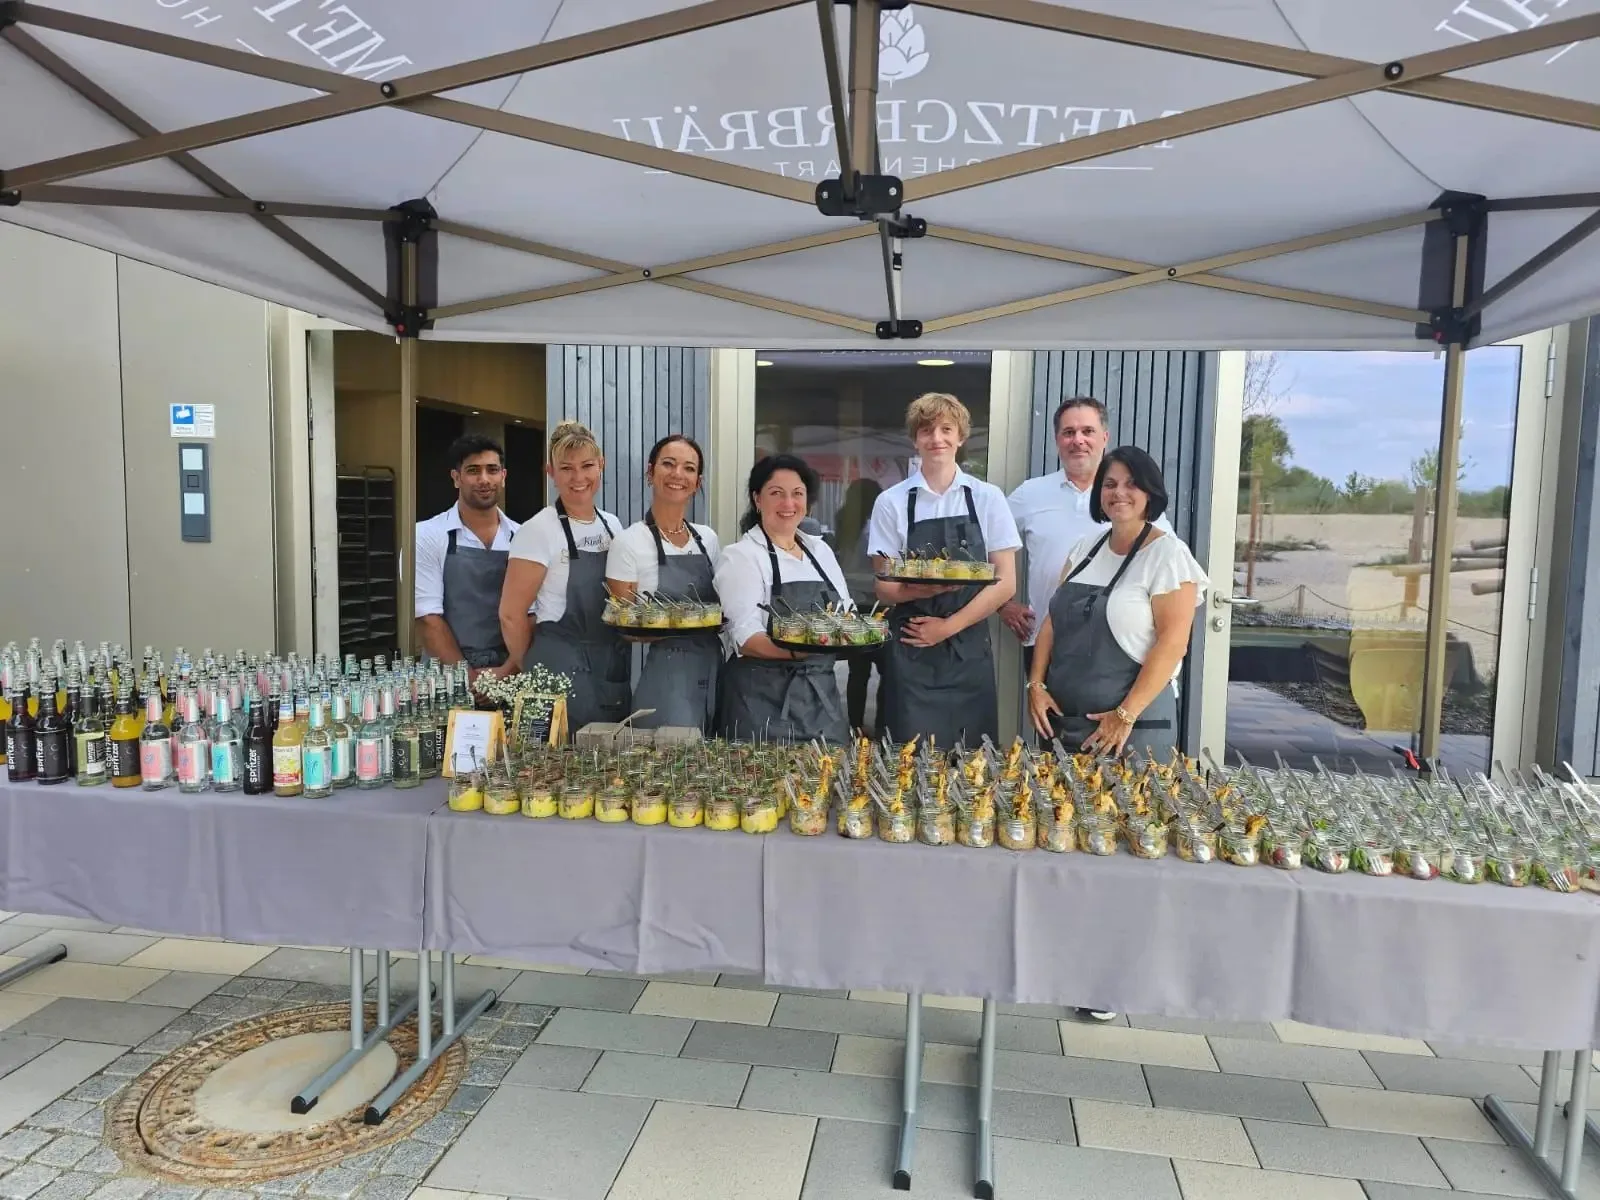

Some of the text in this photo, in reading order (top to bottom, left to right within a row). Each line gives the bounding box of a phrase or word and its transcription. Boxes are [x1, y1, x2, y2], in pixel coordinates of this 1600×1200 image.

[7, 736, 15, 770] spritzer
[36, 738, 45, 773] spritzer
[111, 742, 120, 776] spritzer
[246, 748, 258, 783] spritzer
